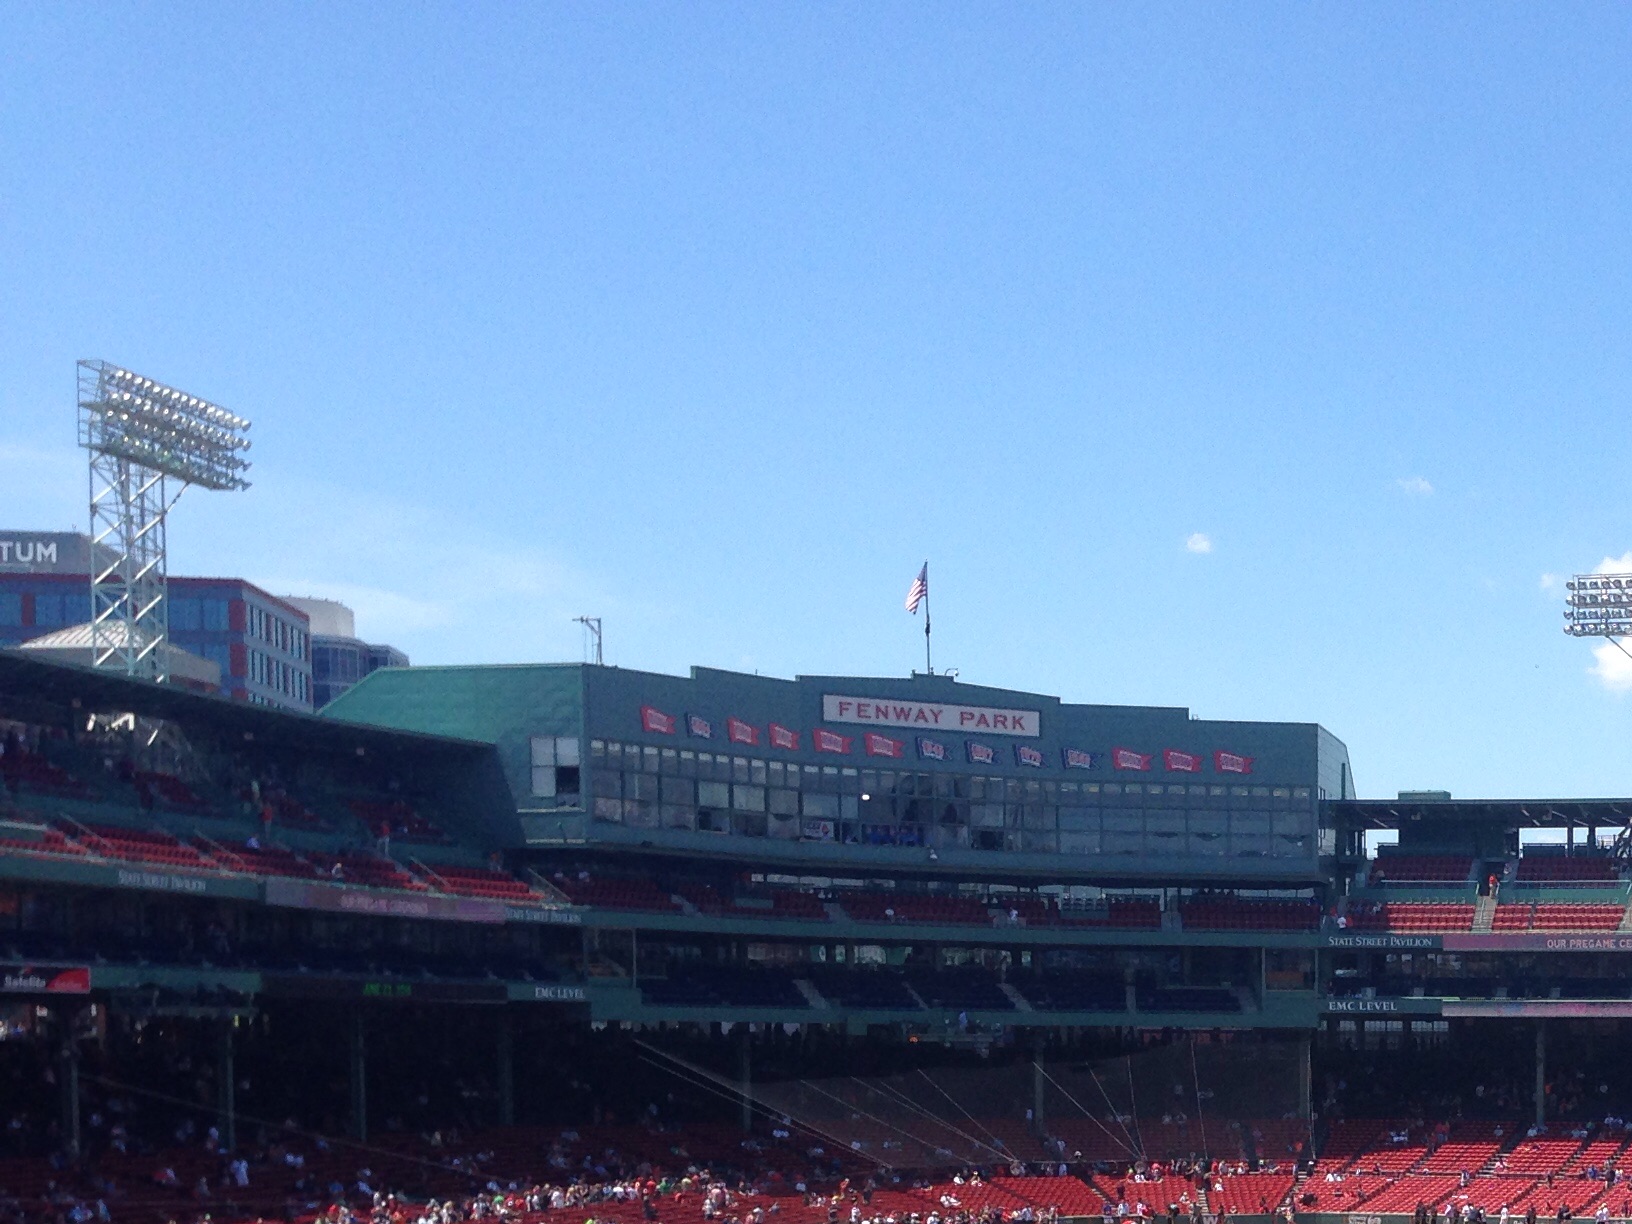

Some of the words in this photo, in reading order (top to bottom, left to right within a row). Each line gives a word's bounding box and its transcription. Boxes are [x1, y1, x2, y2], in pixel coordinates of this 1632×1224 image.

[838, 700, 943, 724] FENWAY
[959, 711, 1026, 731] PARK
[1328, 936, 1353, 946] STATE
[1356, 936, 1387, 946] STREET
[1390, 937, 1432, 947] PAVILION
[1547, 939, 1567, 949] OUR
[1569, 939, 1616, 949] PREGAME
[1329, 1001, 1355, 1011] EMC
[1359, 1001, 1398, 1011] LEVEL
